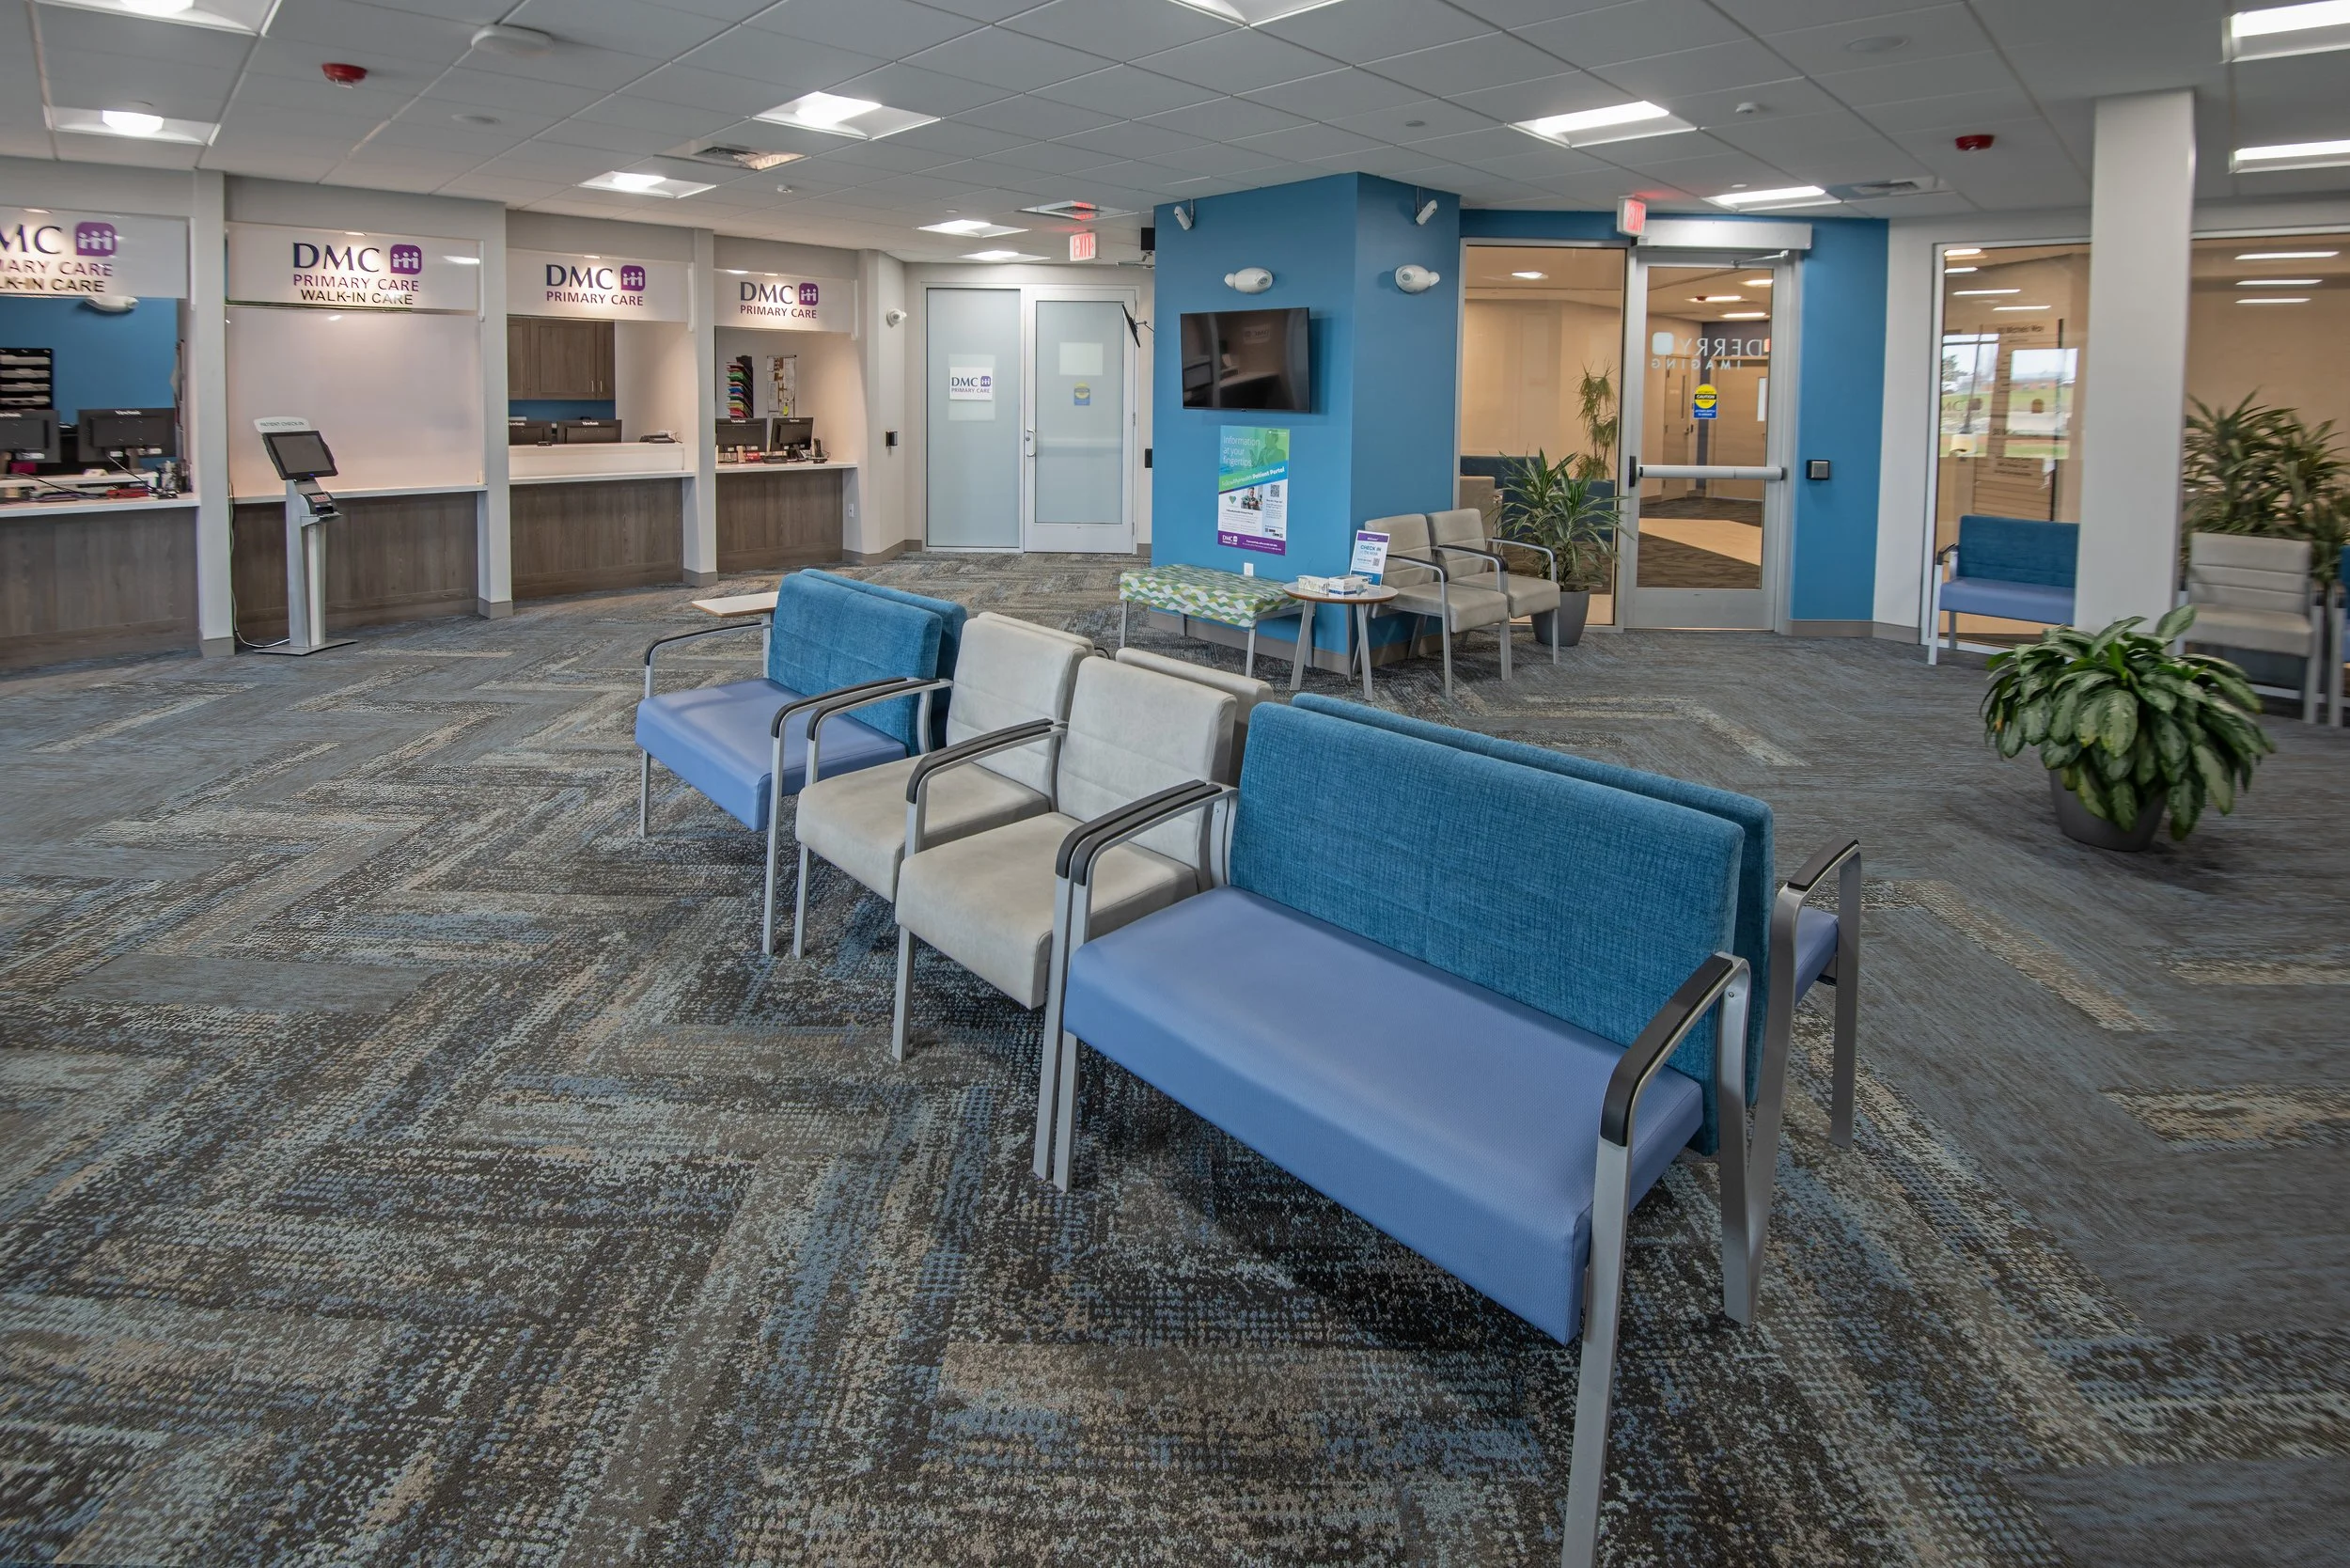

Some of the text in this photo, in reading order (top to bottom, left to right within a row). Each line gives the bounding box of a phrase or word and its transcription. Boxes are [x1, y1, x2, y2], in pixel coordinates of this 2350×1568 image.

[1073, 233, 1092, 259] EXIT
[293, 242, 380, 273] DMC
[0, 259, 114, 276] ARY CARE
[293, 274, 419, 292] PRIMARY CARE
[546, 263, 613, 290] DMC
[51, 278, 106, 293] CARE
[740, 281, 793, 305] DMC
[301, 290, 414, 306] WALK-IN CARE
[546, 290, 644, 306] PRIMARY CARE
[740, 305, 817, 319] PRIMARY CARE
[951, 376, 979, 387] DMC
[1223, 435, 1261, 447] Information
[1223, 447, 1245, 457] at your
[1252, 471, 1270, 479] Patient
[1270, 466, 1285, 475] Portal
